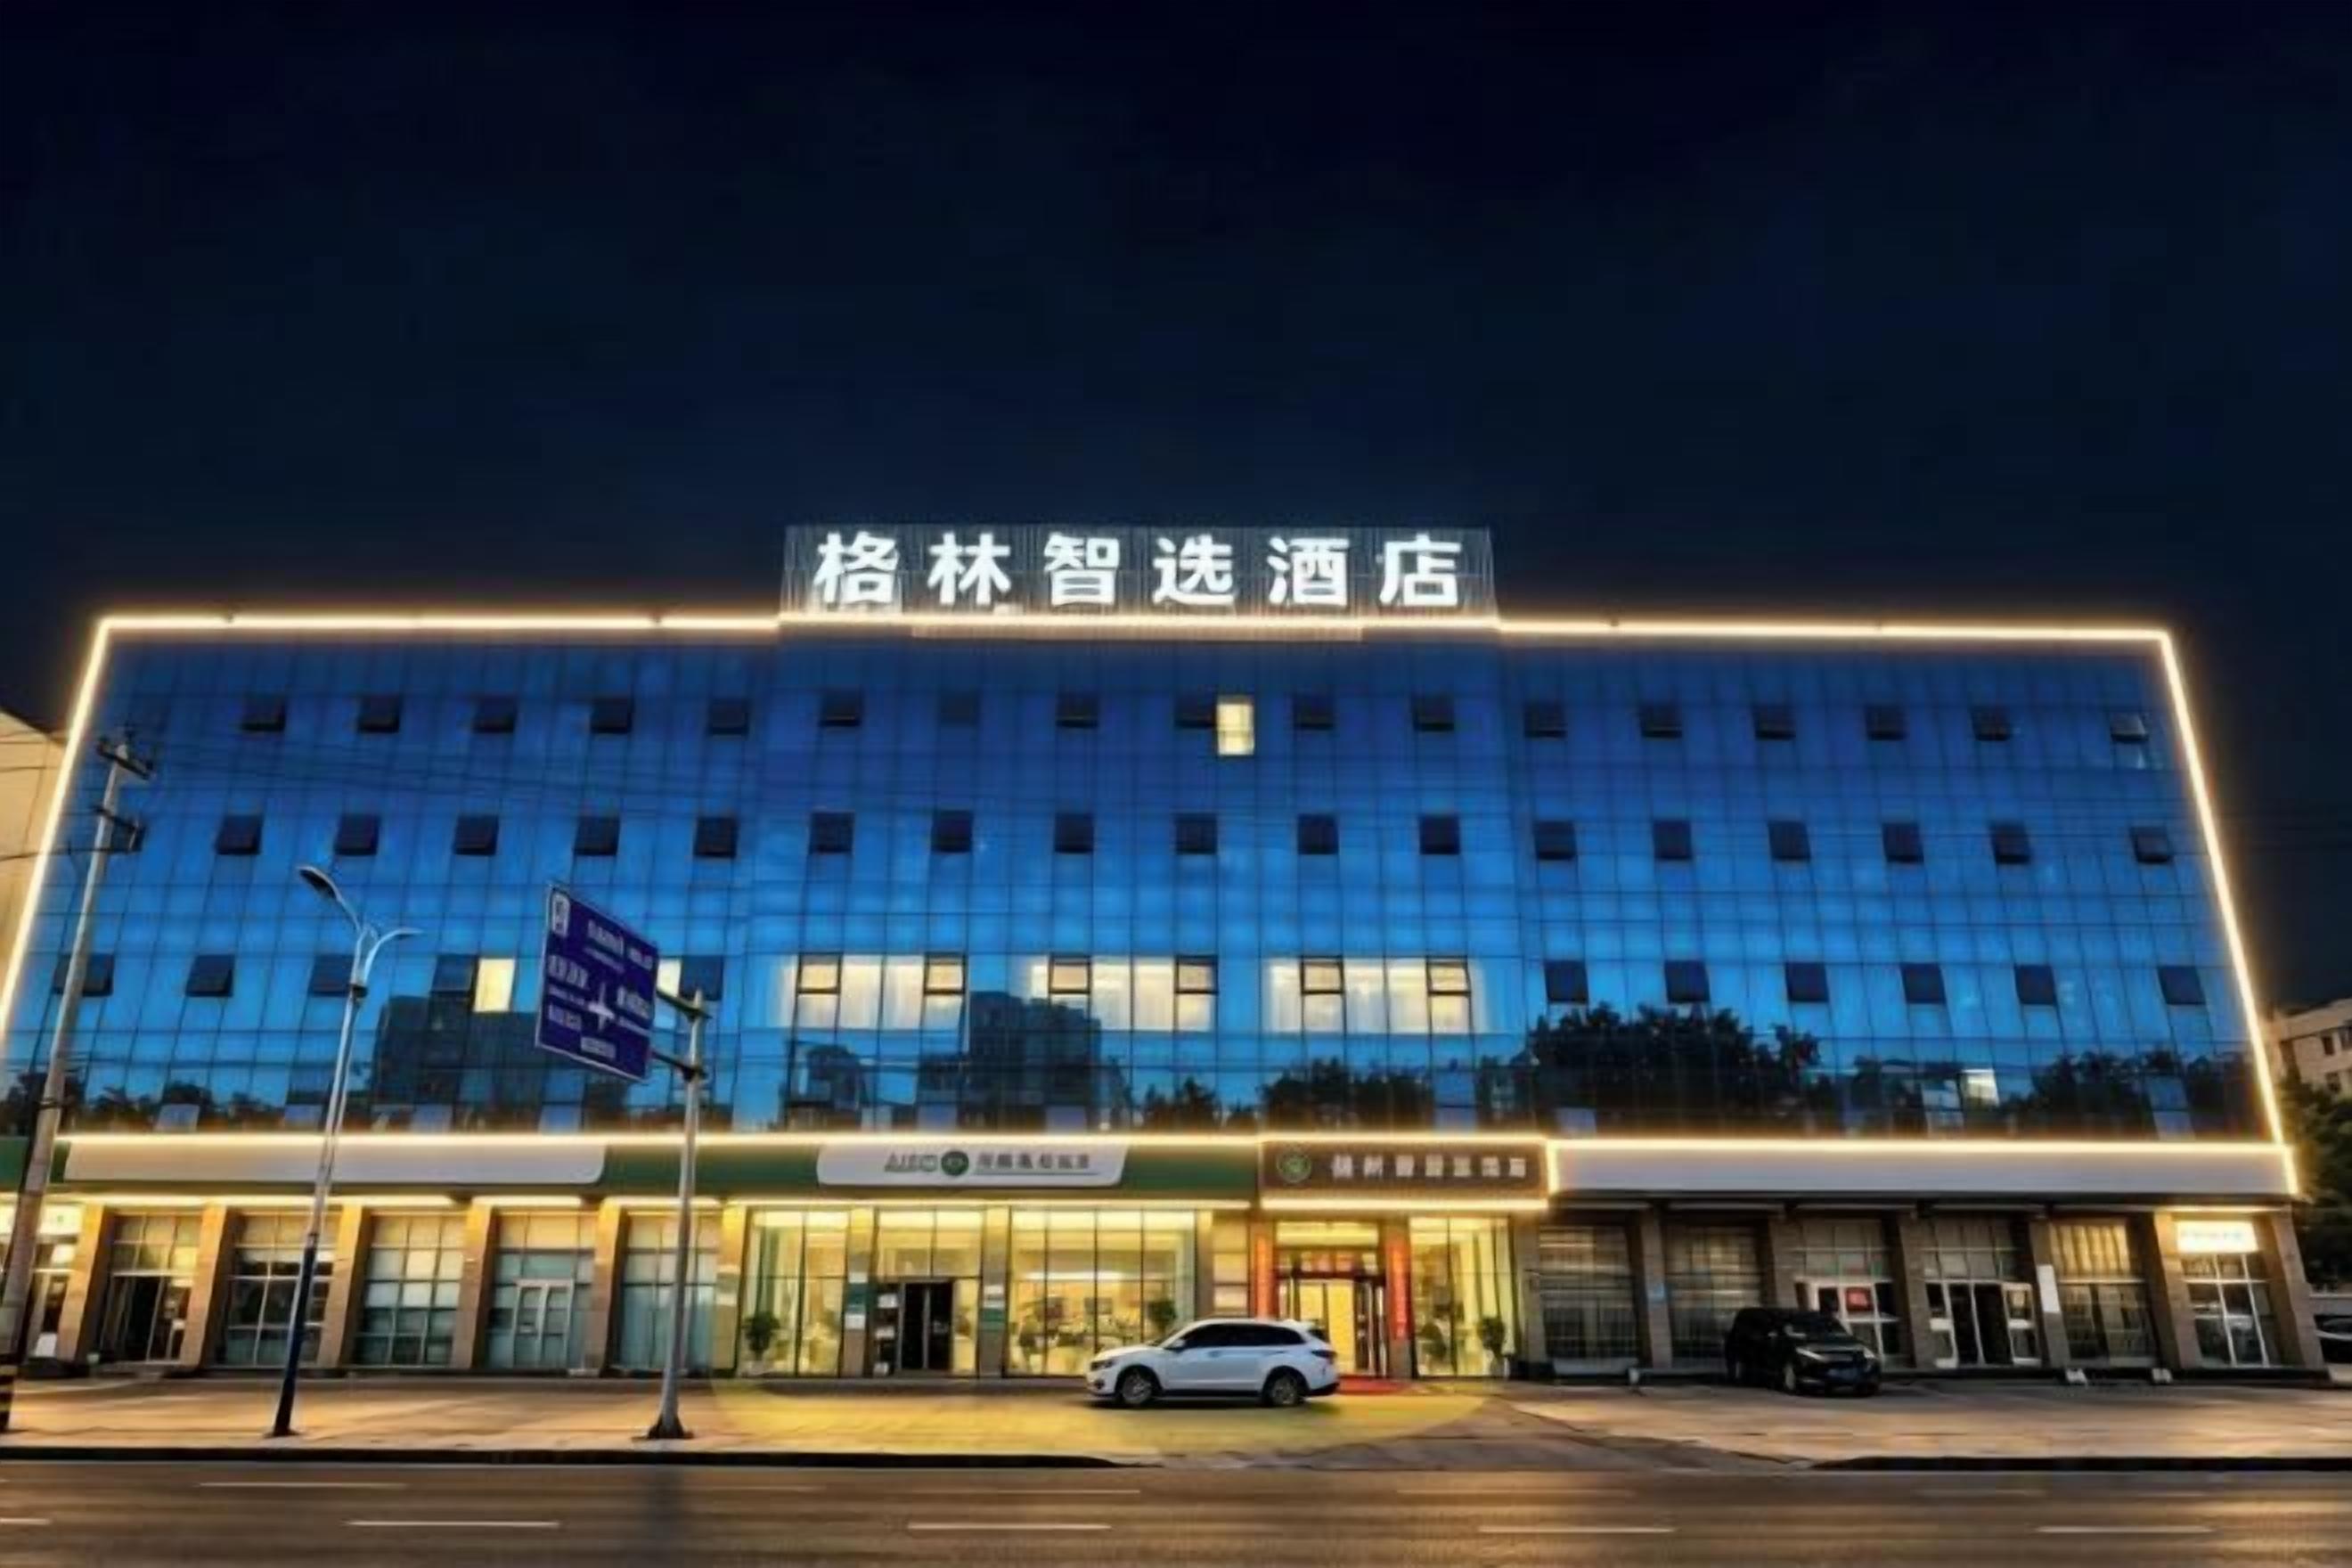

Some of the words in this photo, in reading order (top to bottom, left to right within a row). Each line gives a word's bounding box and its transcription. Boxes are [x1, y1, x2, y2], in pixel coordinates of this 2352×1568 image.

[813, 531, 1463, 608] 格林智选酒店
